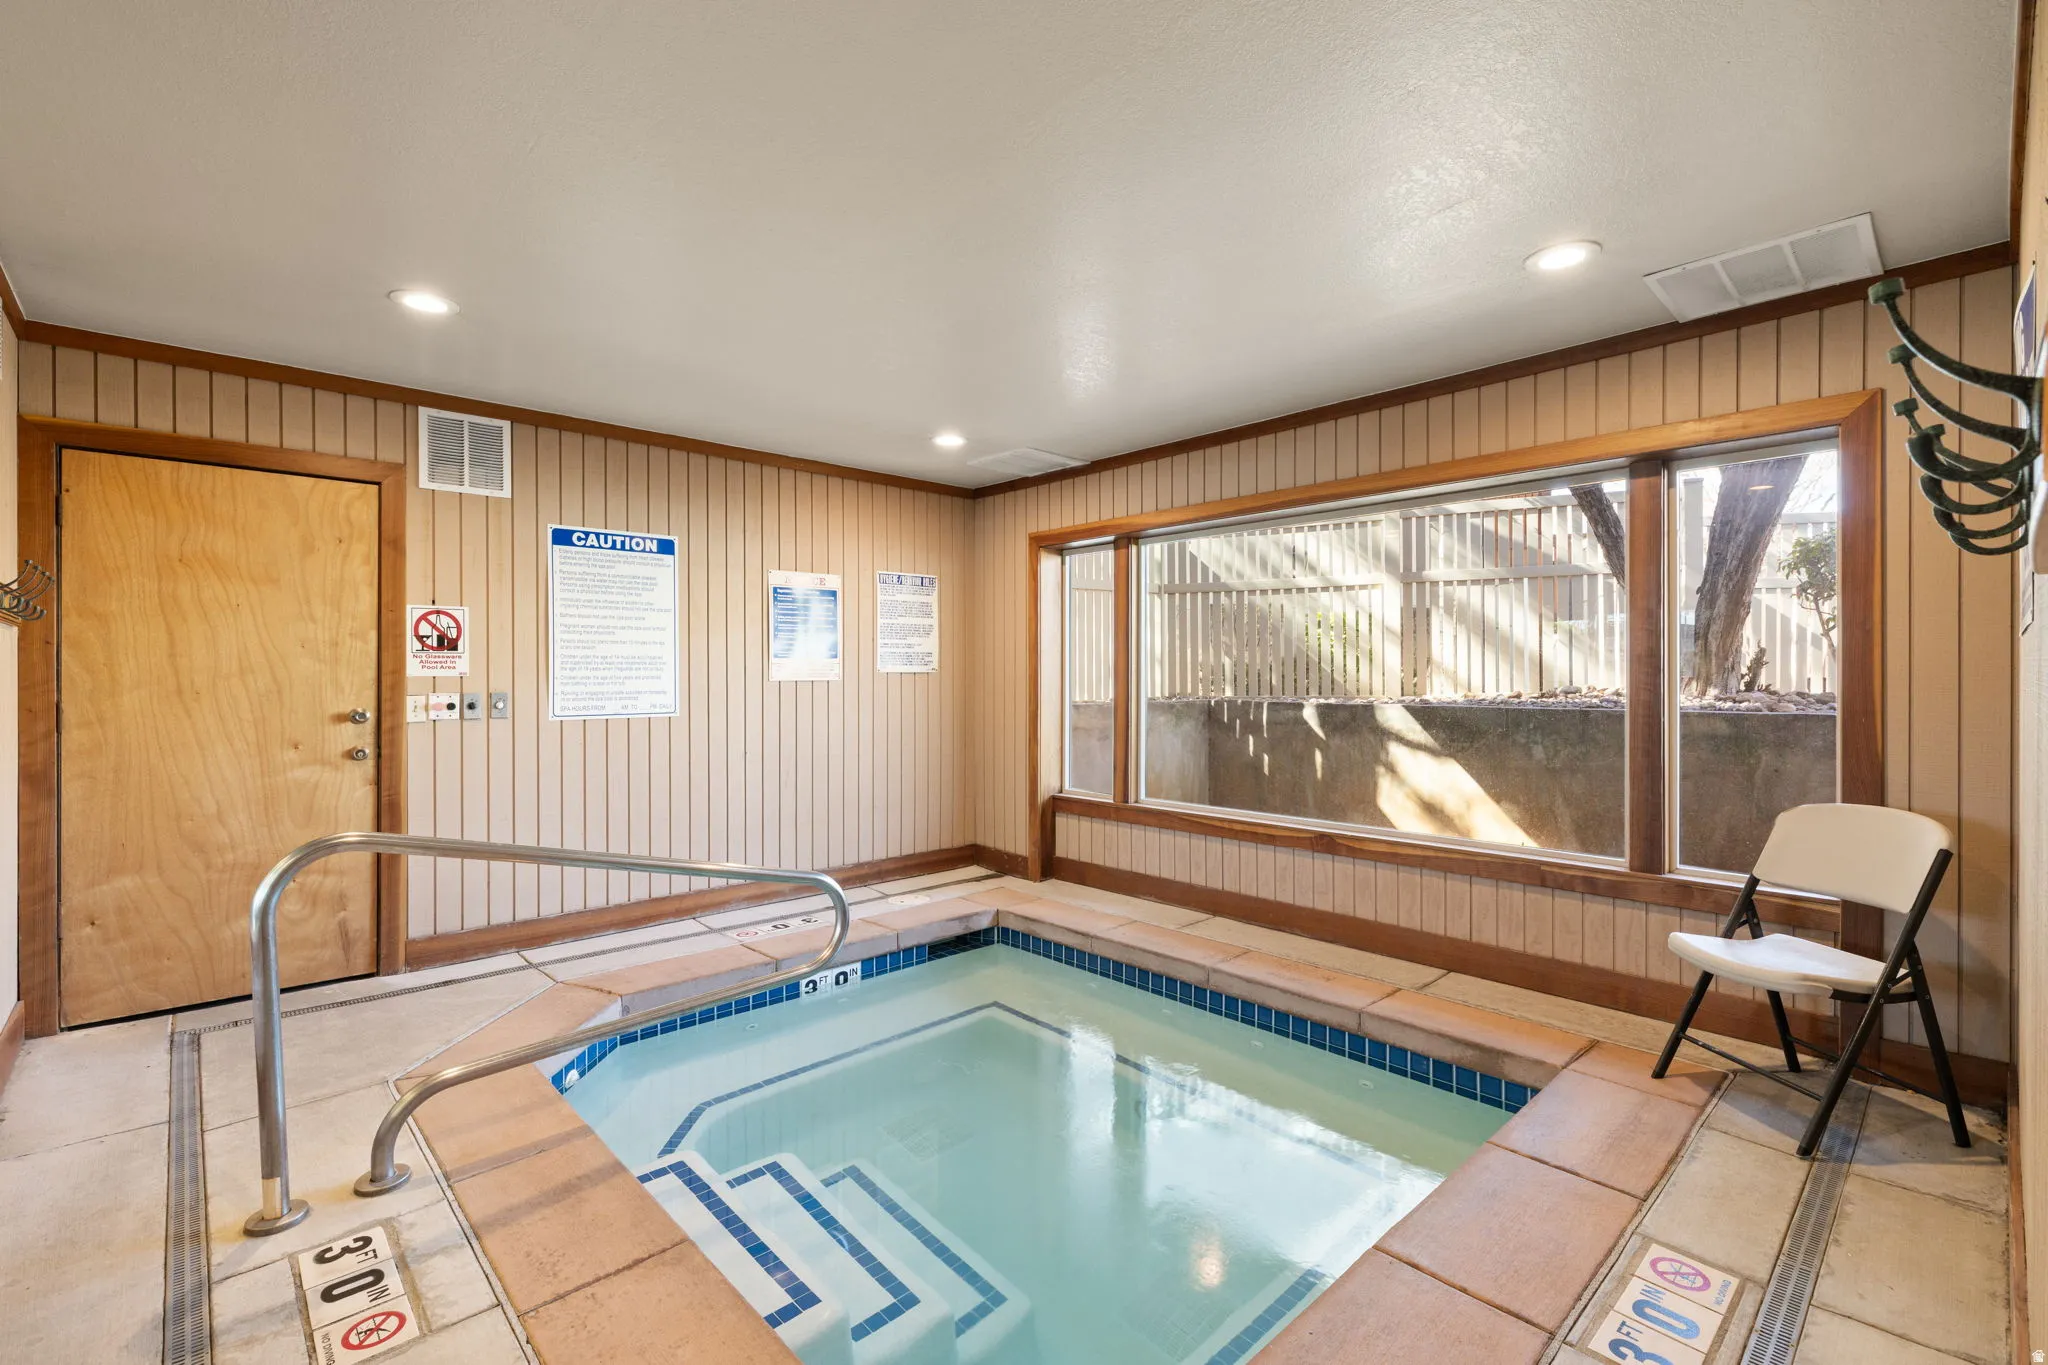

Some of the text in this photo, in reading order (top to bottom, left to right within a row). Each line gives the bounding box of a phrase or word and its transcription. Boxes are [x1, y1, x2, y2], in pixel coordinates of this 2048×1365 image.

[572, 532, 658, 552] CAUTION
[804, 968, 858, 994] 3 FT 0 IN
[312, 1235, 391, 1304] 3 FT 0 IN
[1639, 1284, 1667, 1304] IN
[1617, 1320, 1643, 1342] FT
[1632, 1299, 1700, 1340] 0
